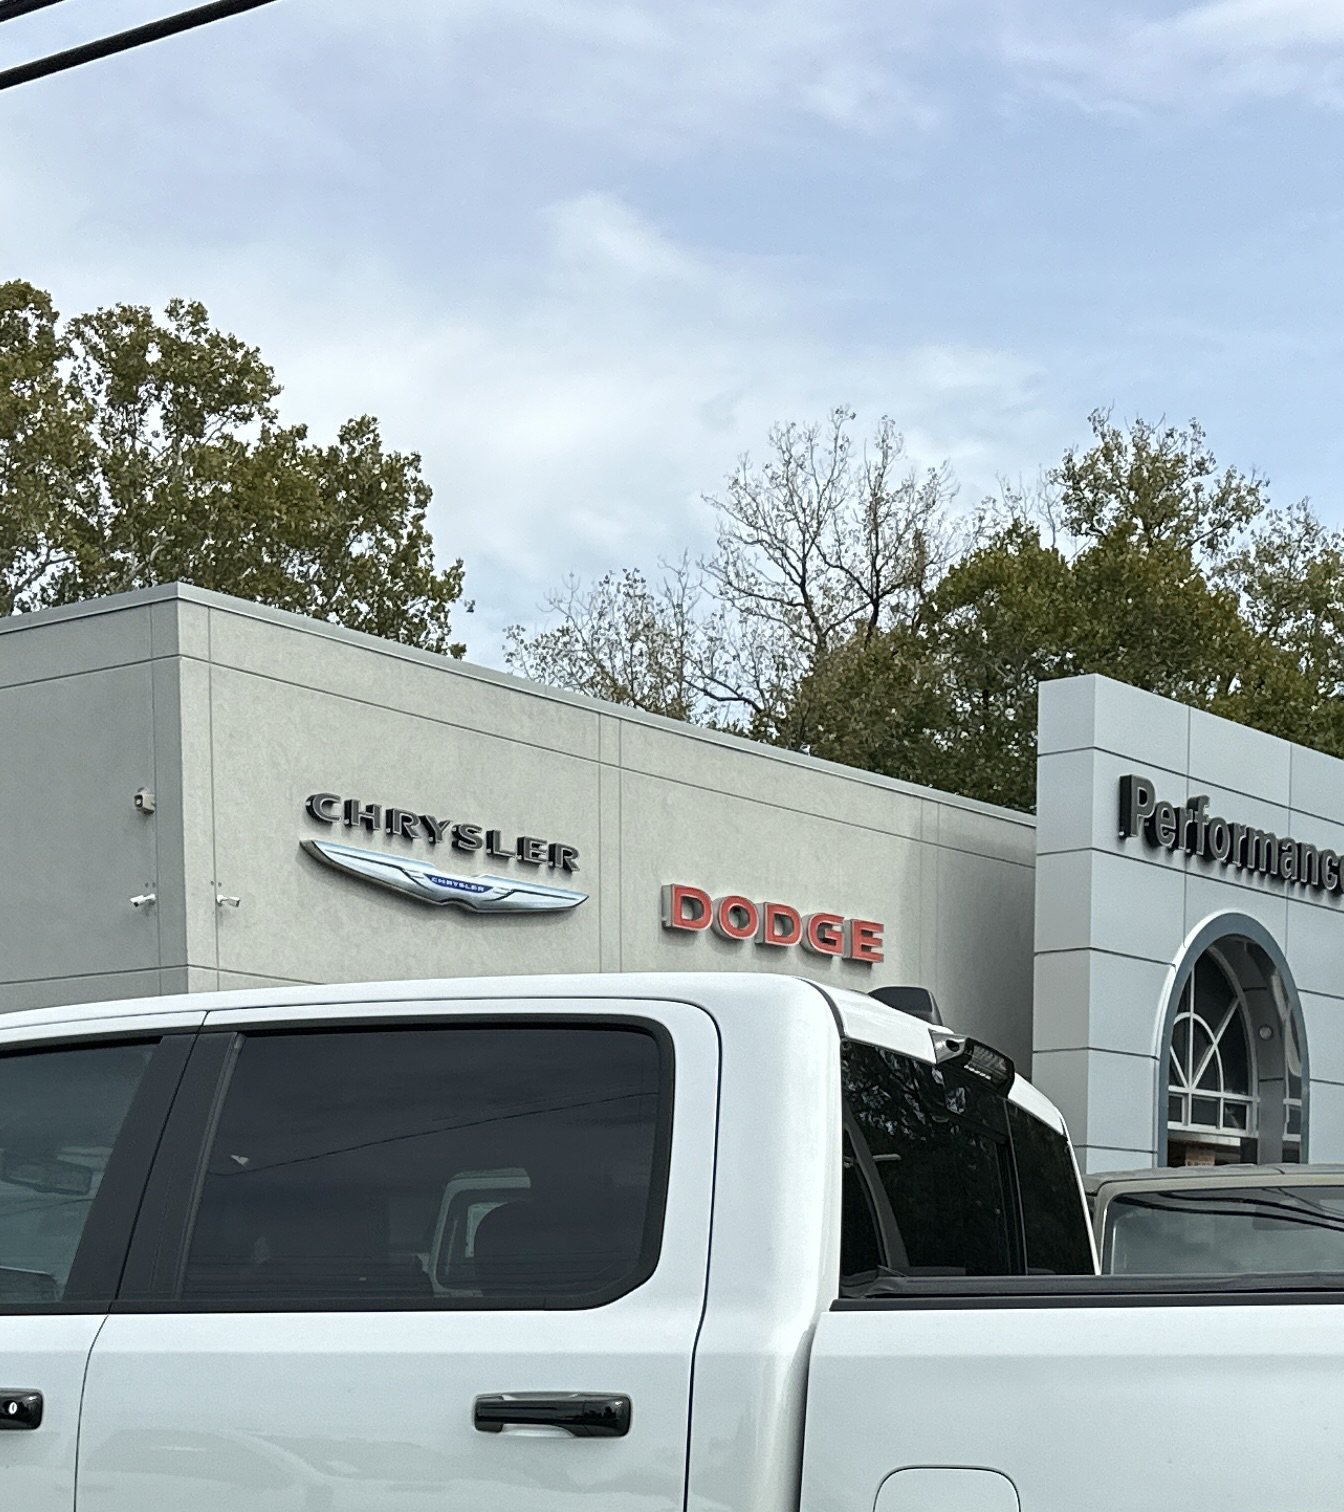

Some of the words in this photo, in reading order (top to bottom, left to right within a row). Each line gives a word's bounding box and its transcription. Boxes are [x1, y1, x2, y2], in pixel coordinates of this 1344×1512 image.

[306, 792, 580, 872] CHRYSLER
[431, 877, 485, 892] CHRYSLER
[661, 883, 885, 964] DODGE
